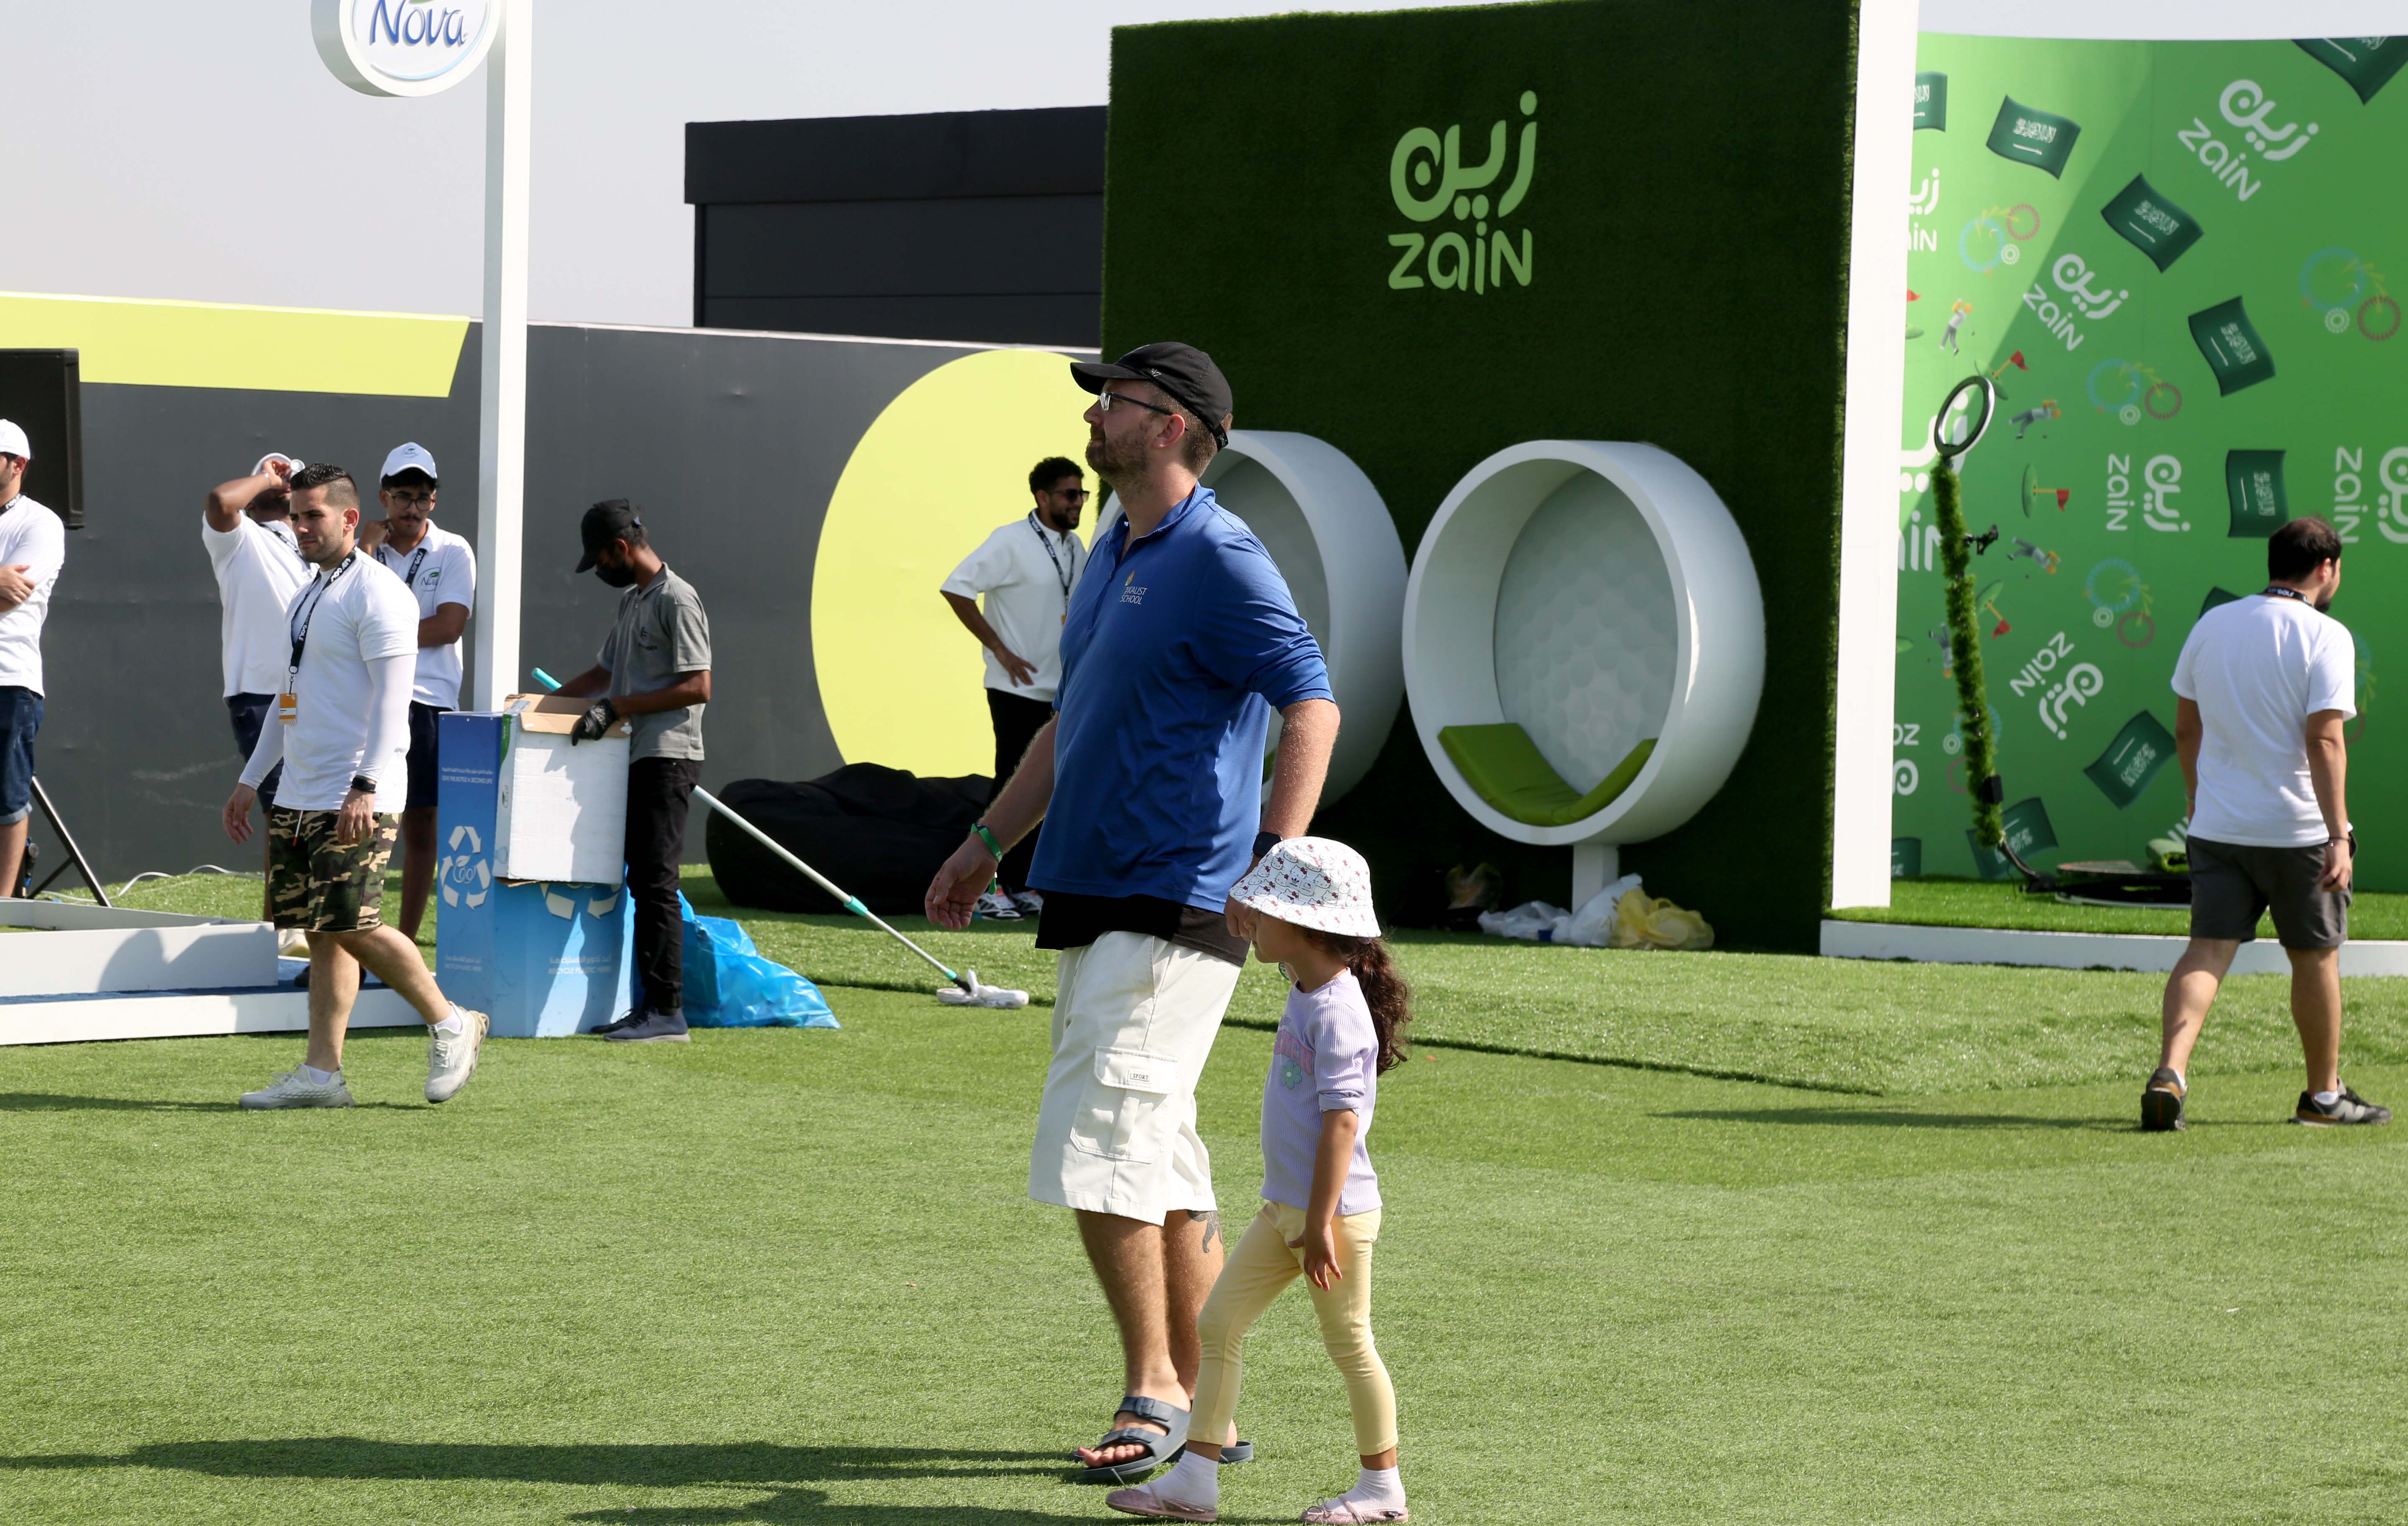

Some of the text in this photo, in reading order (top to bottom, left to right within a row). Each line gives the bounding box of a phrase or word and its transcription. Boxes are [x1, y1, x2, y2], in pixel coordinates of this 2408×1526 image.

[370, 0, 467, 46] Nova
[1390, 90, 1537, 222] زين
[2219, 79, 2319, 161] زين
[2052, 253, 2129, 319] زين
[2143, 454, 2191, 532] زين
[1119, 594, 1142, 605] SCHOOL
[1127, 586, 1148, 596] KAUST
[2039, 662, 2104, 740] زين
